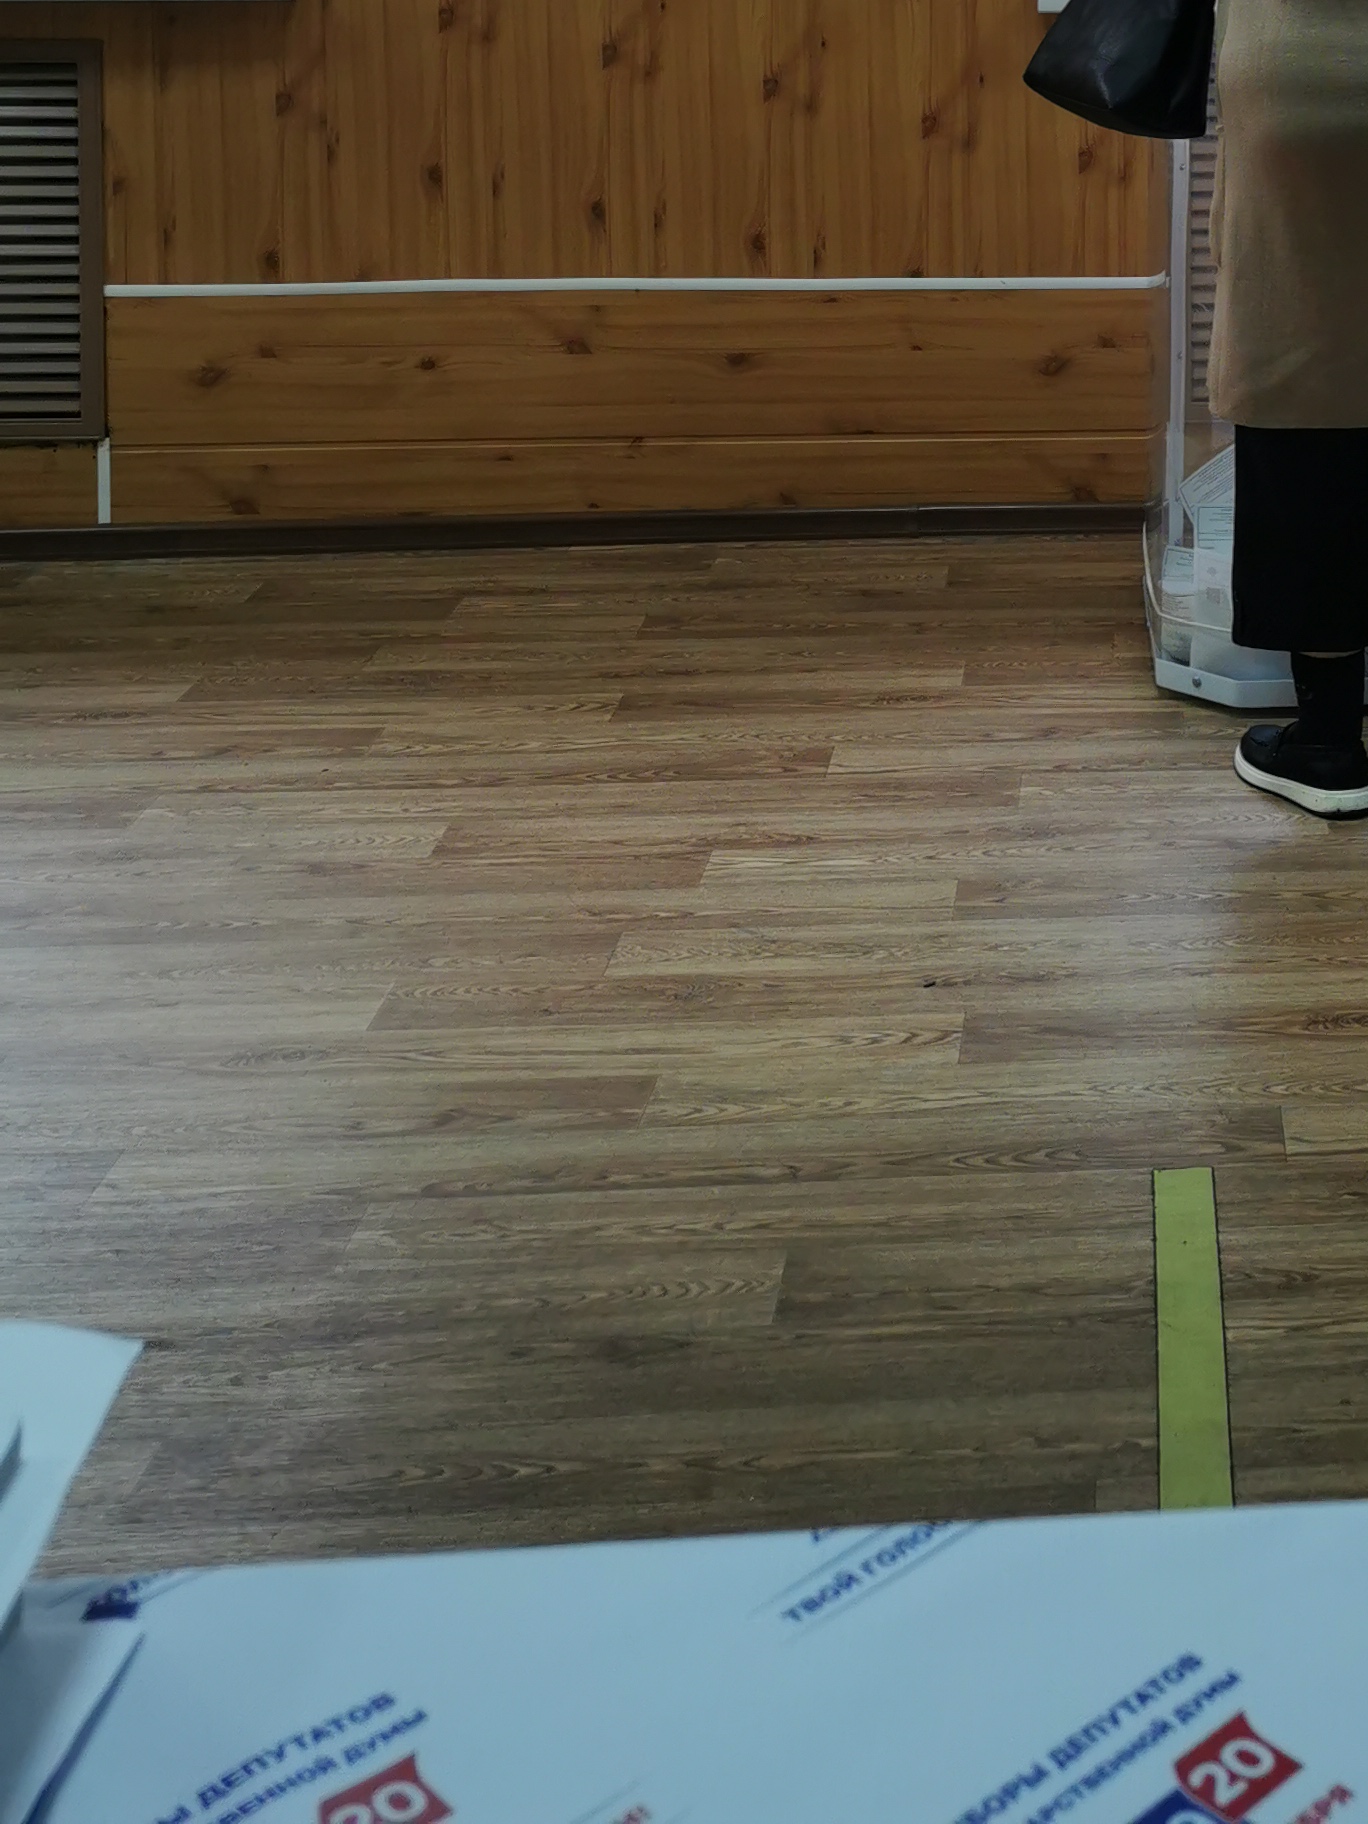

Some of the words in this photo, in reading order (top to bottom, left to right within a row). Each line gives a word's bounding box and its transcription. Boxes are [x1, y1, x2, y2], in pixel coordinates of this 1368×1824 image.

[780, 1570, 863, 1622] ТВОЙ
[860, 1521, 950, 1576] ГОЛО
[196, 1690, 395, 1811] ДЕПУТАТОВ
[1048, 1648, 1203, 1771] ДЕПУТАТОВ
[1188, 1737, 1276, 1808] 20
